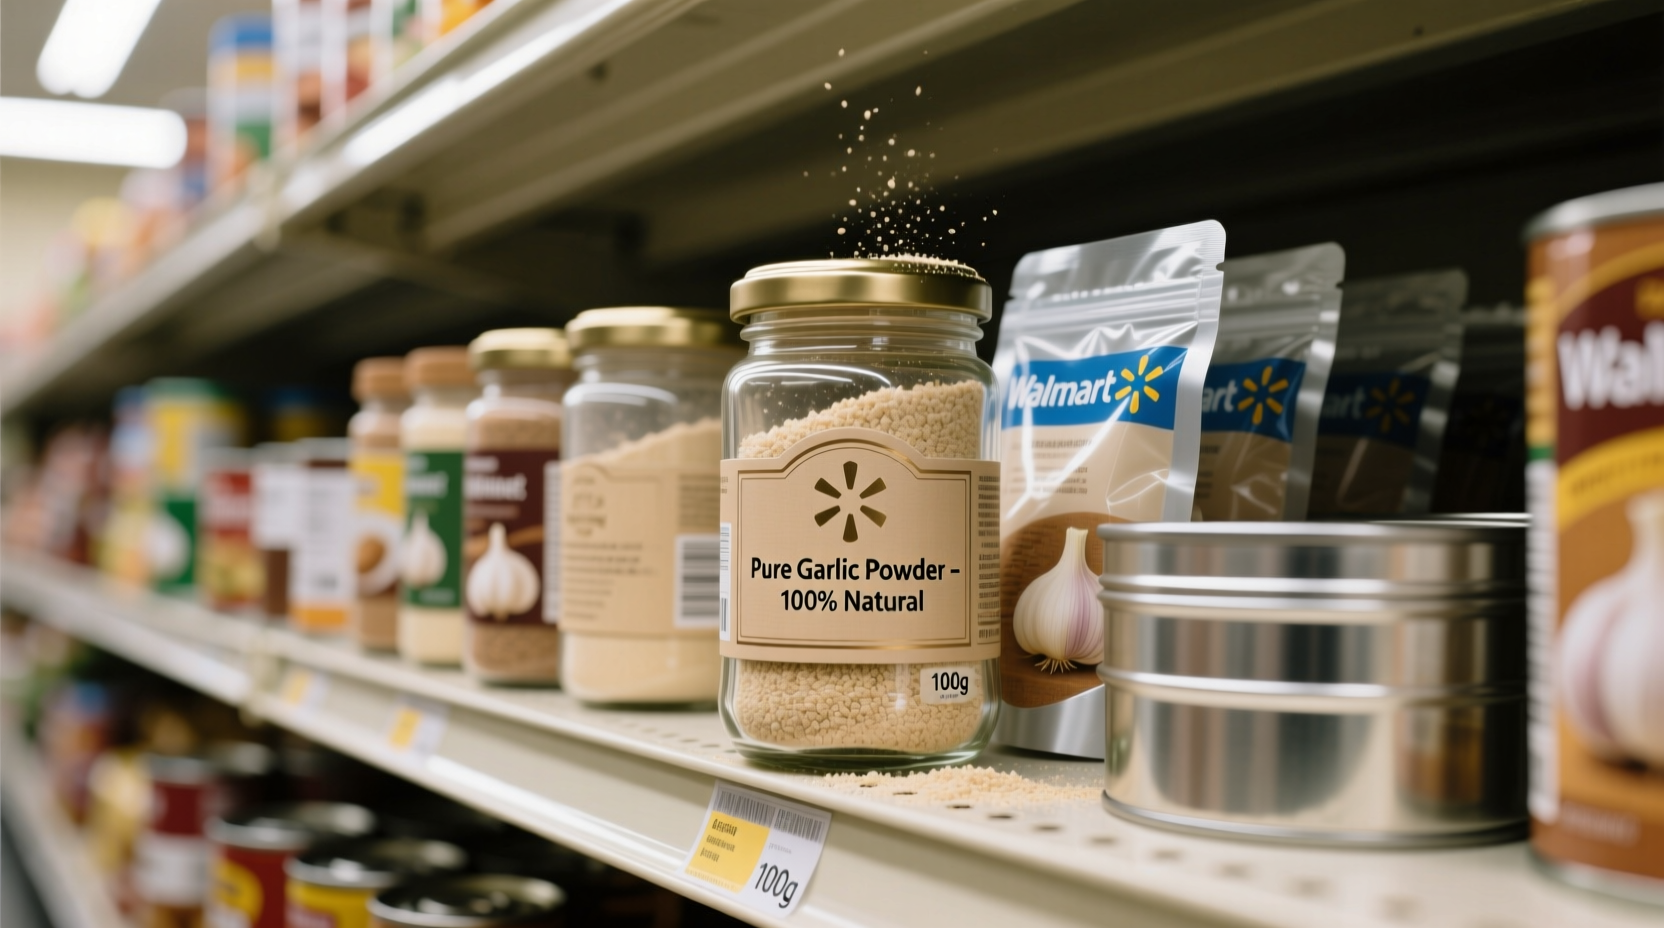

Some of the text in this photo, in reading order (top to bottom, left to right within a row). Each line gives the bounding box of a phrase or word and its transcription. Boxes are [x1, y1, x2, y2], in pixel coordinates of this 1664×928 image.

[1007, 369, 1117, 410] Walmart
[751, 557, 792, 579] Pure
[797, 557, 860, 581] Garlic
[865, 557, 946, 581] Powder
[780, 589, 924, 612] 100% Natural
[931, 671, 969, 696] 100g
[755, 862, 799, 909] 100g
